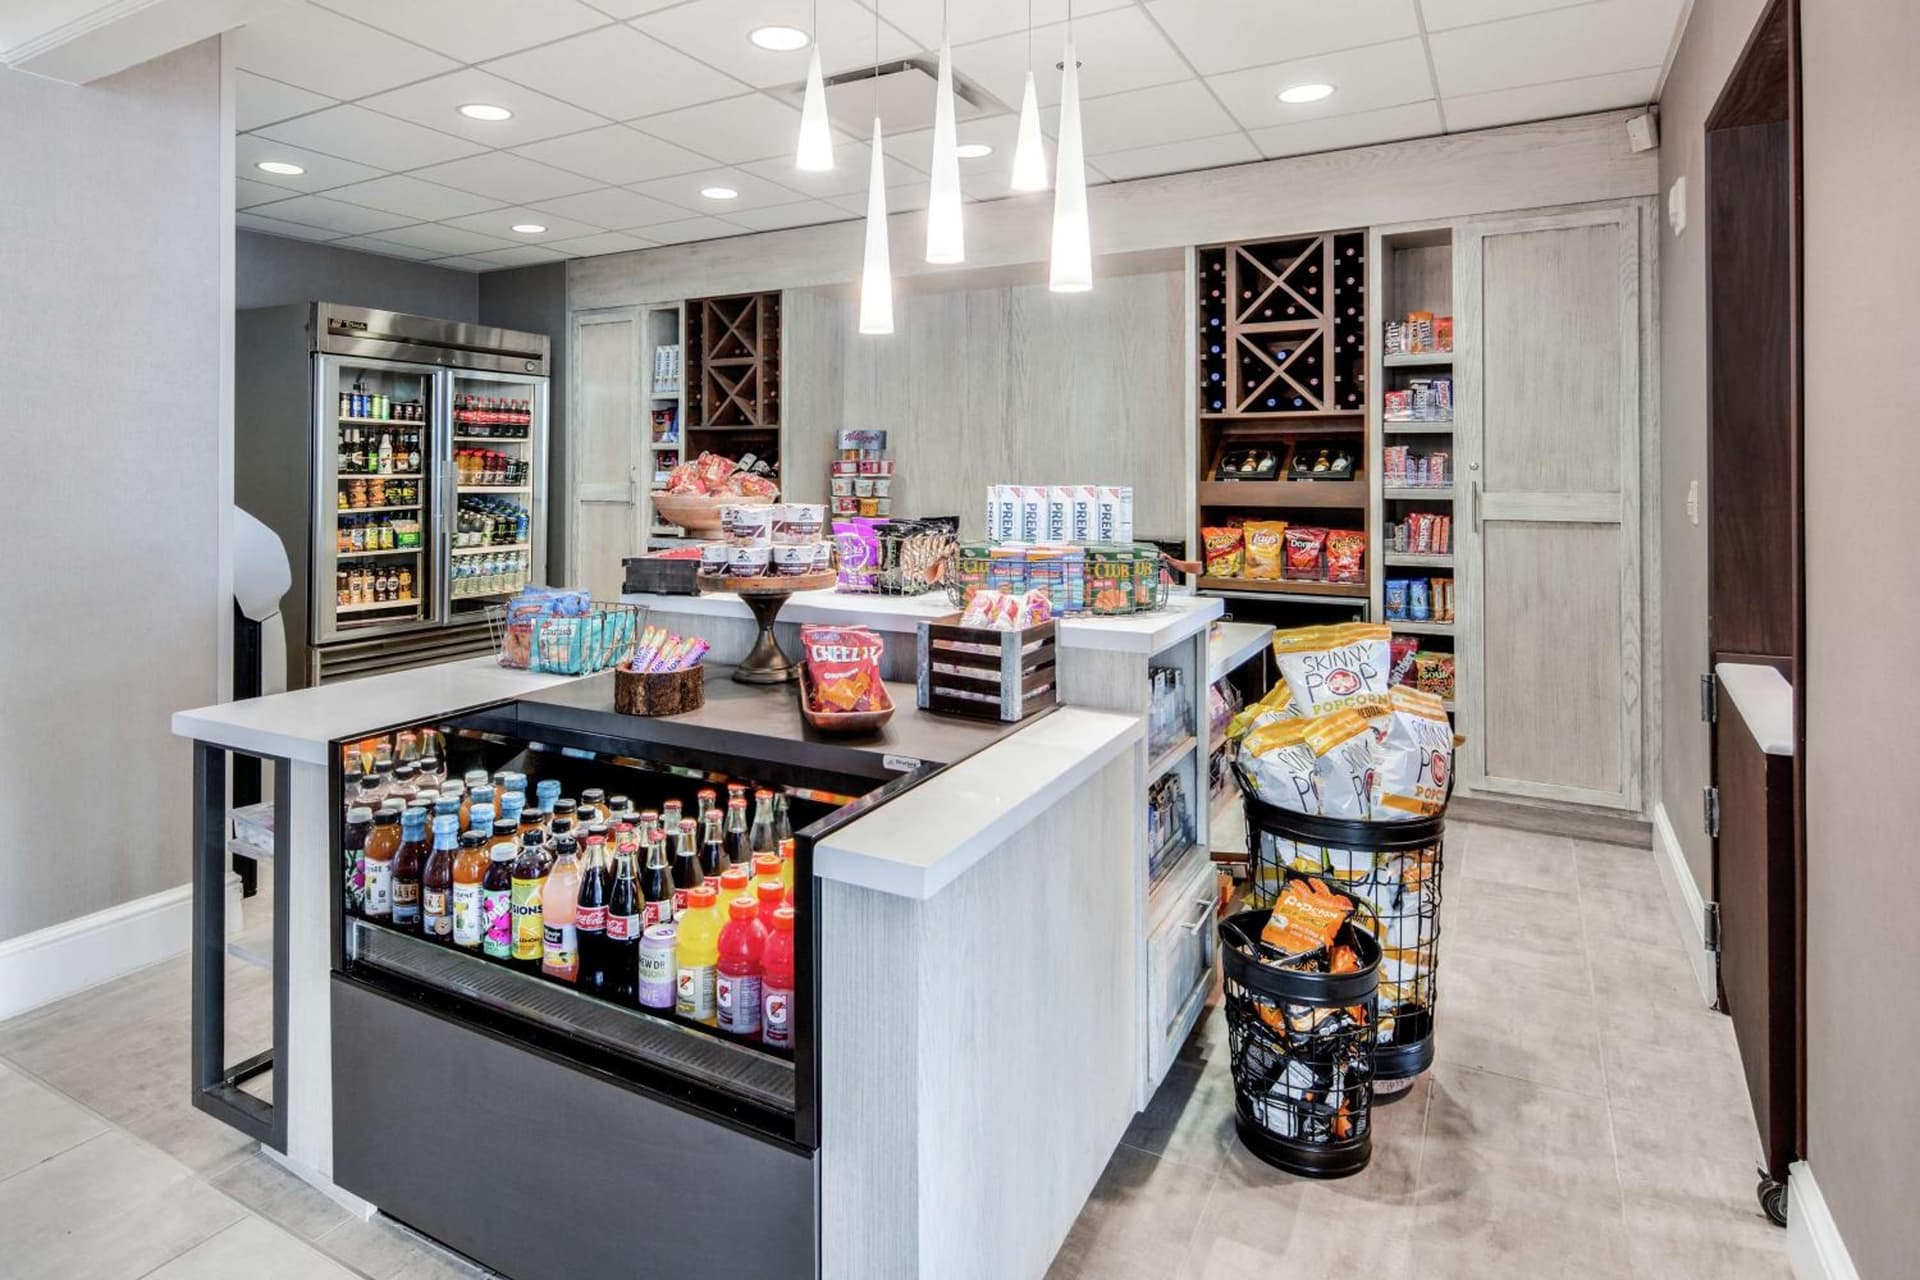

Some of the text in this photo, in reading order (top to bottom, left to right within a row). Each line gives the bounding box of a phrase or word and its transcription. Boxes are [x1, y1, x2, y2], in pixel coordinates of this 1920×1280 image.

[1095, 563, 1129, 578] CLUB
[1302, 643, 1373, 674] SKINNY
[1304, 662, 1378, 703] POP
[1313, 694, 1392, 715] POPCORN
